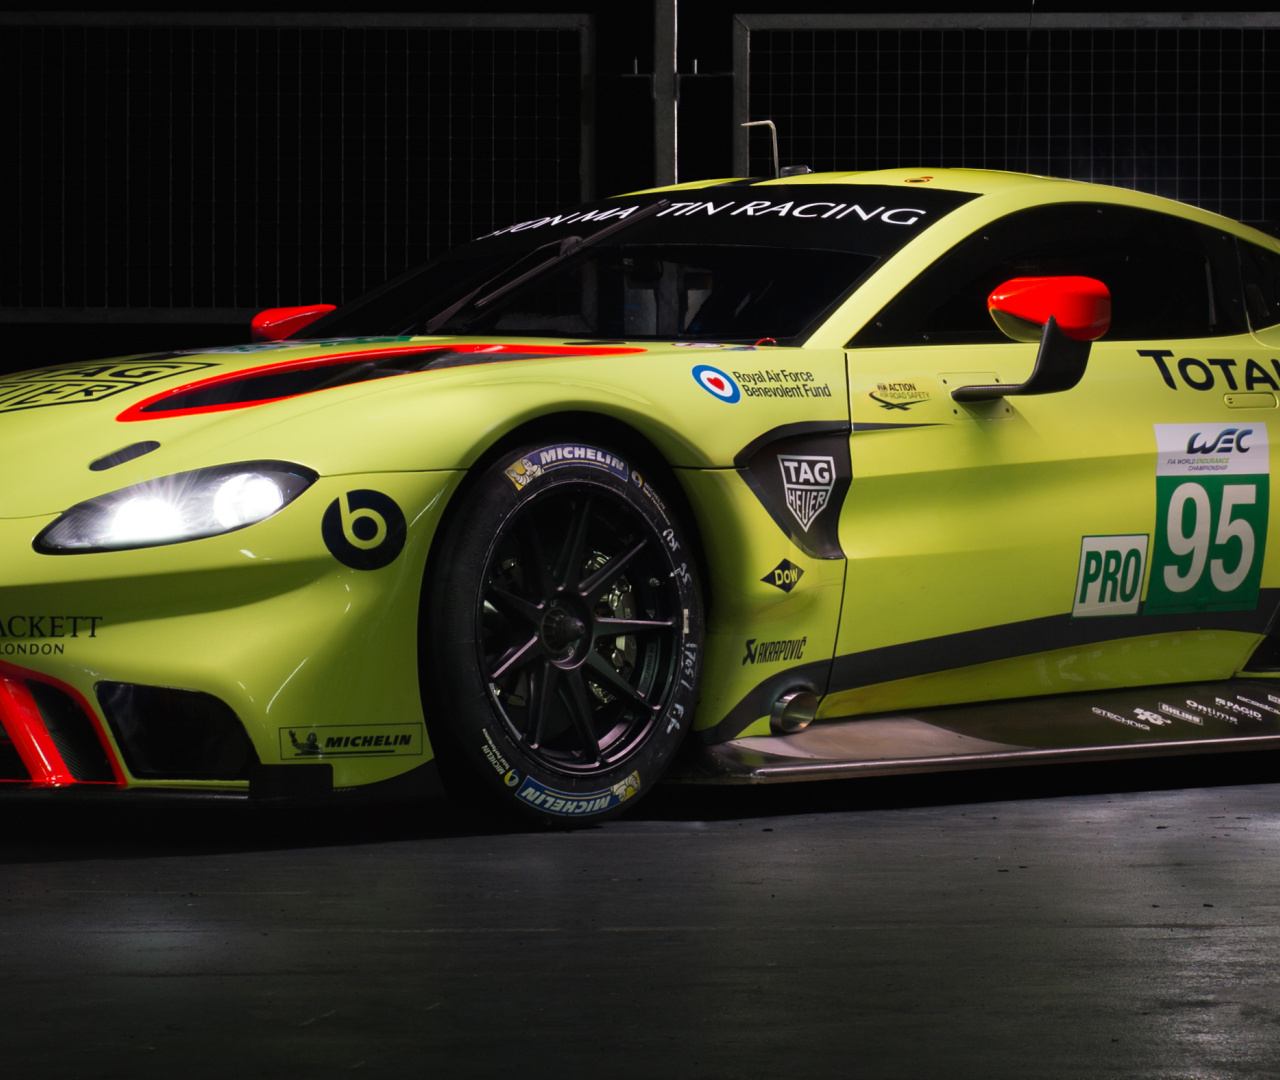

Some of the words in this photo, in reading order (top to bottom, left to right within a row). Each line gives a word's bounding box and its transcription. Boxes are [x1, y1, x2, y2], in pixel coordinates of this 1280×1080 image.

[567, 201, 735, 224] MATIN
[731, 199, 927, 226] RACING
[732, 369, 766, 386] Royal
[765, 369, 782, 383] Air
[780, 369, 815, 382] Force
[888, 383, 917, 391] ACTION
[741, 384, 805, 398] Benevolent
[802, 383, 832, 398] Fund
[1186, 428, 1253, 454] WEC
[539, 446, 625, 471] MICHELIN
[783, 461, 830, 484] TAG
[788, 489, 827, 525] HEUER
[1163, 481, 1257, 592] 95
[774, 569, 798, 585] DOW
[1078, 547, 1142, 604] PRO
[1226, 701, 1262, 718] PAGID
[324, 734, 412, 748] MICHELIN
[481, 744, 506, 775] MICHELIN
[521, 787, 611, 813] MICHELIN
